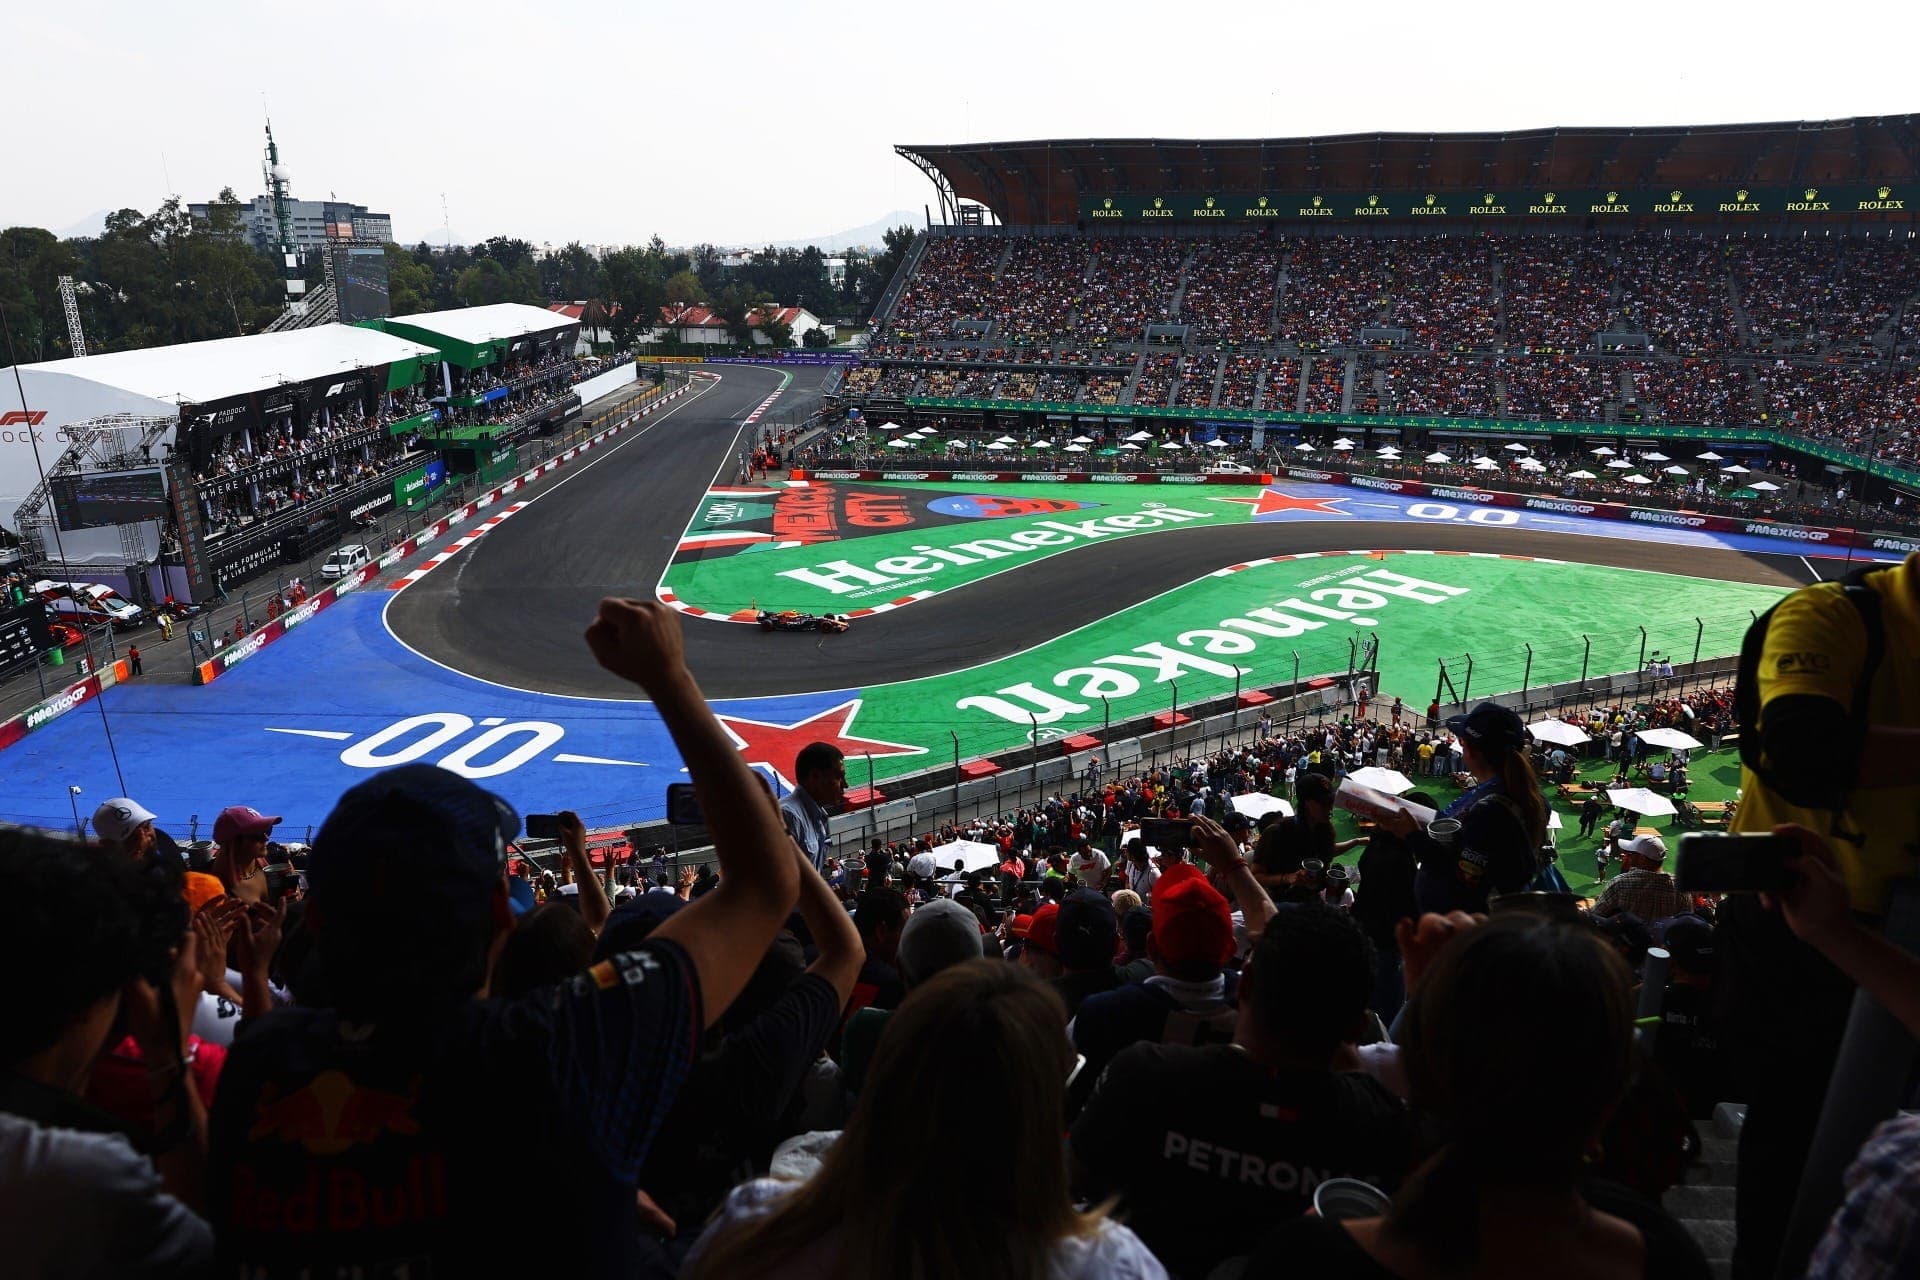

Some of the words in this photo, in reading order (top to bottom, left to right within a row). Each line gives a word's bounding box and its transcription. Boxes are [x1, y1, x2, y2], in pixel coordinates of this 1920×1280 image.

[1469, 205, 1506, 214] ROLEX
[1529, 205, 1567, 213] ROLEX
[1590, 204, 1630, 213] ROLEX
[1654, 203, 1694, 212] ROLEX
[1719, 203, 1760, 211] ROLEX
[1786, 202, 1830, 211] ROLEX
[1857, 200, 1904, 210] ROLEX
[1142, 209, 1173, 217] ROLEX
[1193, 209, 1225, 217] ROLEX
[1245, 208, 1279, 216] ROLEX
[1299, 208, 1333, 216] ROLEX
[1355, 207, 1389, 215] ROLEX
[1411, 206, 1447, 215] ROLEX
[218, 405, 247, 418] PADDOCK
[217, 416, 235, 425] CLUB
[199, 480, 239, 501] WHERE
[244, 455, 307, 485] ADRENALINE
[311, 446, 339, 462] MEETS
[343, 431, 381, 451] ELEGANCE
[814, 472, 861, 480] #MexicoGP
[882, 472, 930, 481] #MexicoGP
[951, 472, 999, 481] #MexicoGP
[1021, 473, 1068, 482] #MexicoGP
[1090, 474, 1138, 483] #MexicoGP
[1160, 475, 1208, 484] #MexicoGP
[1287, 469, 1332, 481] #MexicoGP
[1351, 476, 1403, 491] #MexicoGP
[1431, 487, 1494, 502] #MexicoGP
[350, 493, 392, 519] paddockclub.com
[1525, 498, 1595, 514] #MexicoGP
[1629, 510, 1706, 527] #MexicoGP
[1745, 523, 1830, 541] #MexicoGP
[225, 560, 239, 572] THE
[241, 546, 272, 566] FORMULA
[231, 565, 248, 578] LIKE
[248, 560, 258, 570] NO
[260, 549, 281, 567] OTHER
[224, 632, 267, 667] #MexicoGP
[26, 686, 87, 729] #MexicoGP
[1163, 1130, 1380, 1196] PETRON
[231, 1163, 320, 1235] Red
[327, 1151, 449, 1233] Bull
